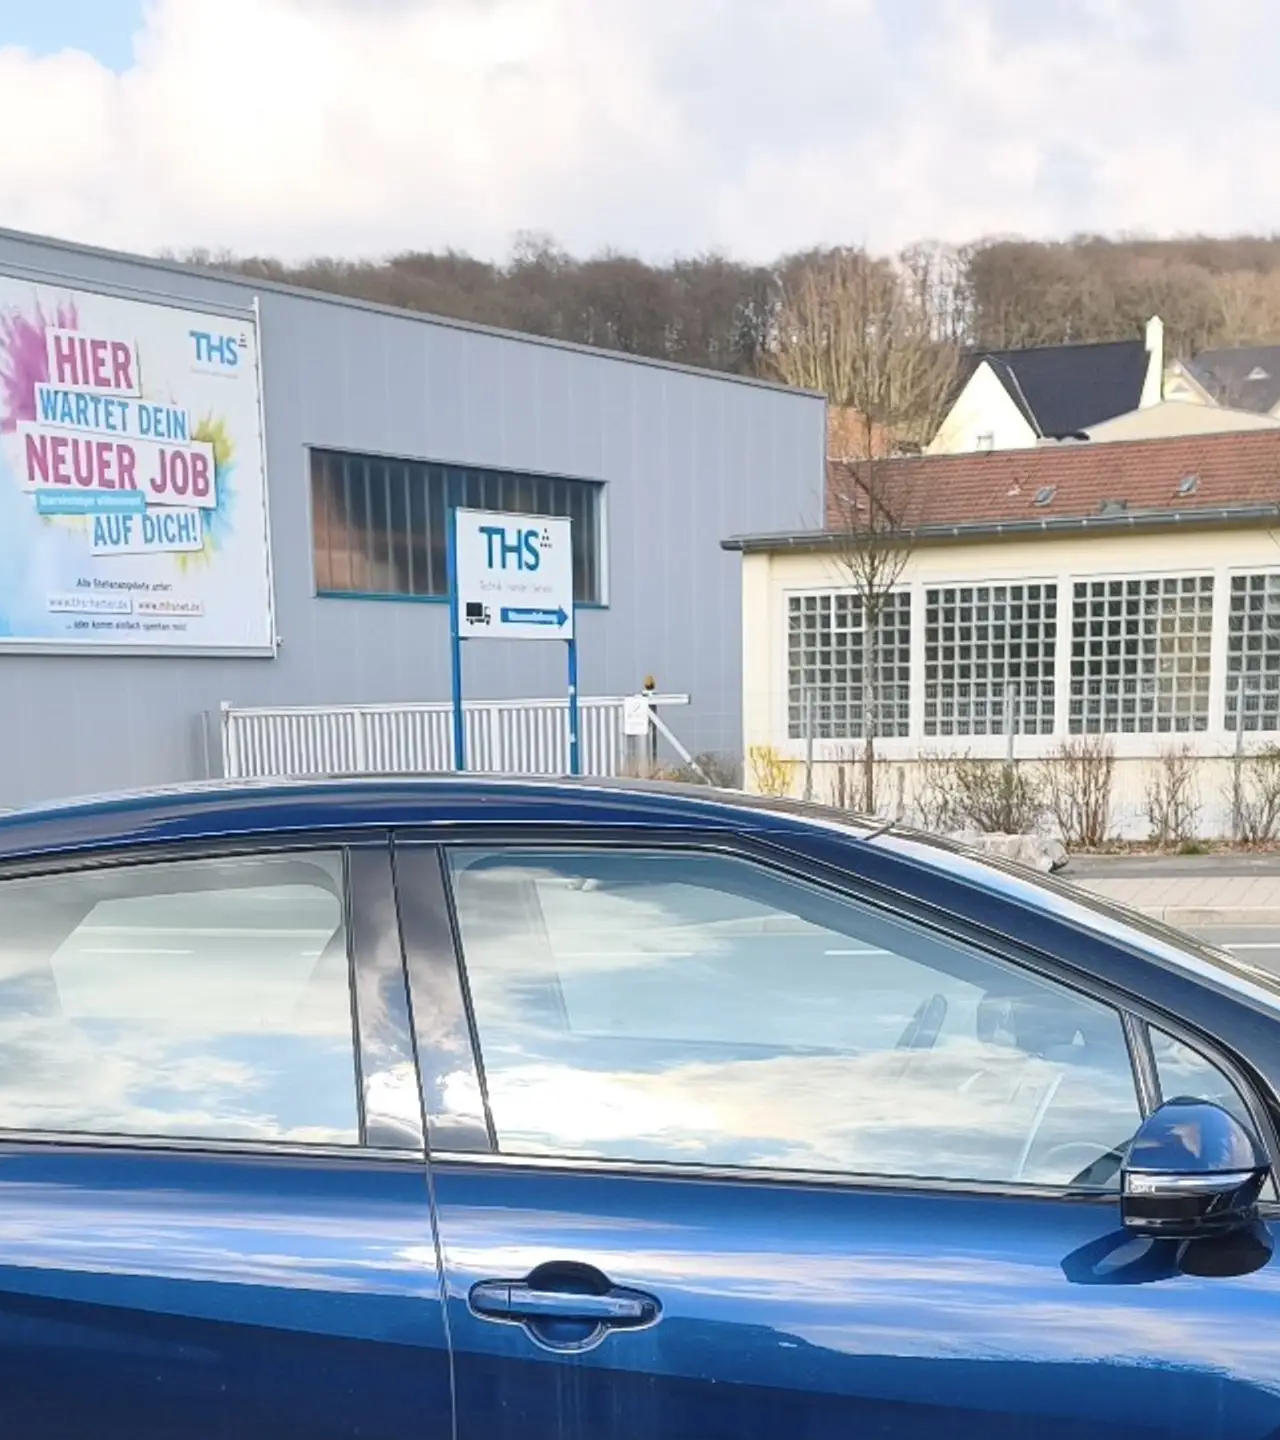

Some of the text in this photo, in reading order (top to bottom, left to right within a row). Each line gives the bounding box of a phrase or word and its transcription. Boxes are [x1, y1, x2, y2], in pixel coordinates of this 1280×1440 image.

[54, 335, 134, 390] HIER
[189, 330, 238, 366] THS
[39, 387, 187, 441] WARTET DEIN
[25, 433, 210, 498] NEUER JOB
[94, 513, 198, 547] AUF DICH!
[478, 526, 540, 571] THS
